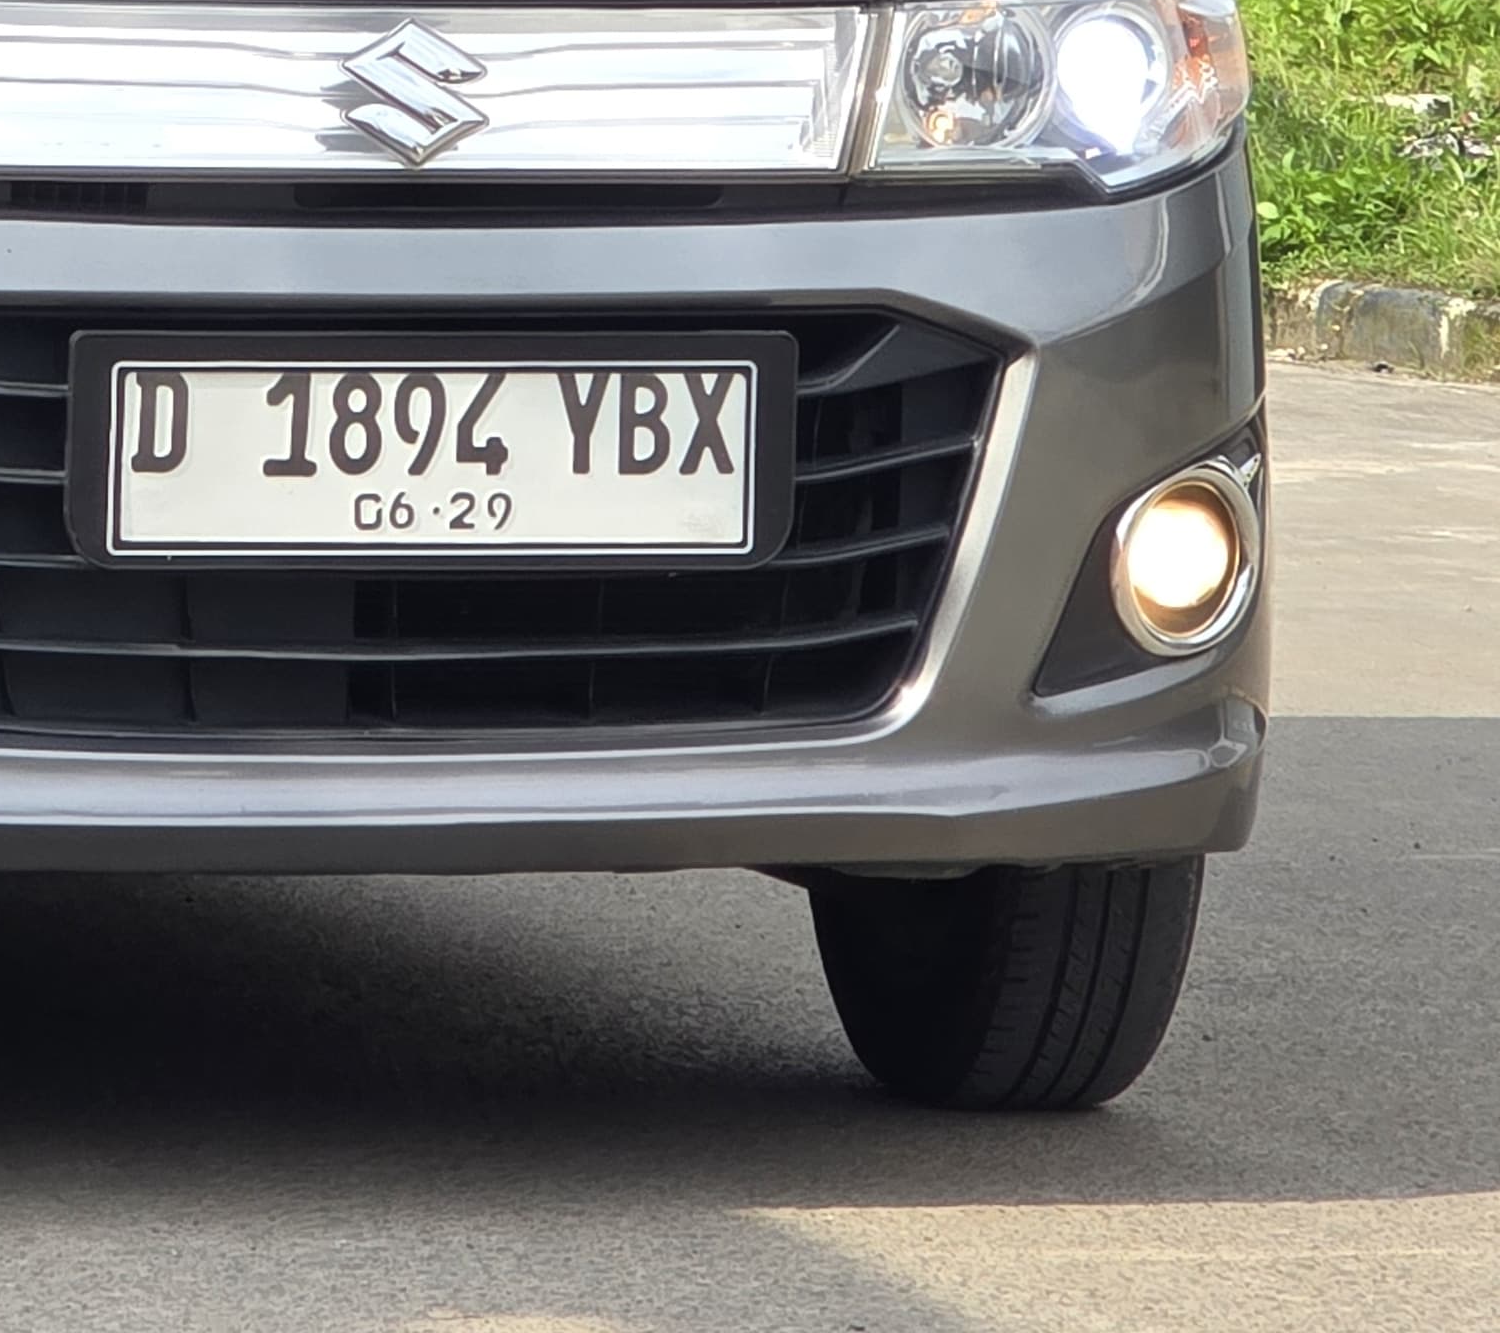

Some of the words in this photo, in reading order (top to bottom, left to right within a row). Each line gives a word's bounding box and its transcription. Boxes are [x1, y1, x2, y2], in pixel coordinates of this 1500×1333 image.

[130, 372, 190, 473] D
[262, 372, 509, 477] 1894
[556, 372, 736, 476] YBX
